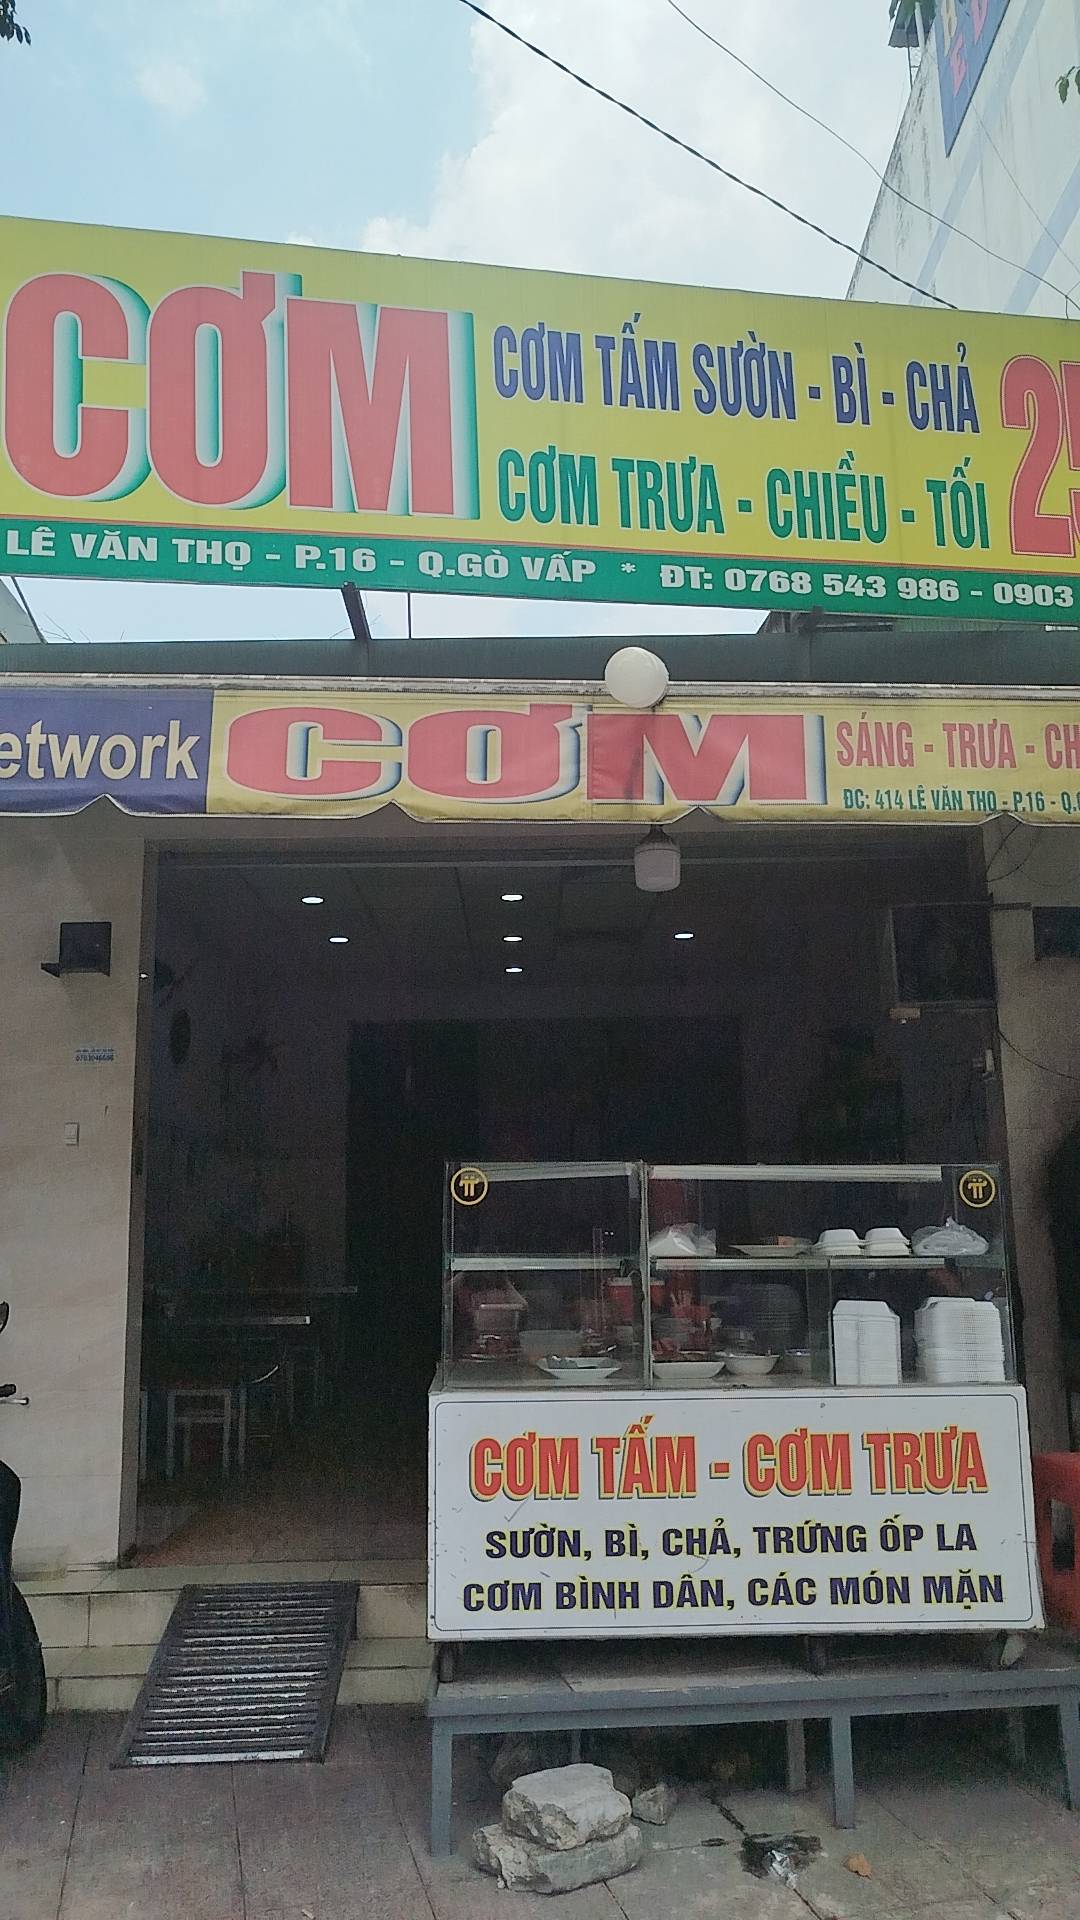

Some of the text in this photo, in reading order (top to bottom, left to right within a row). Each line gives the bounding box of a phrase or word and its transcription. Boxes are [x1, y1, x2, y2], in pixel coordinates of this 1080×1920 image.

[4, 271, 481, 519] CƠM
[492, 321, 584, 404] CƠM
[594, 312, 681, 412] TẤM
[691, 330, 797, 420] SƯỜN
[831, 342, 871, 426] BÌ
[905, 342, 980, 434] CHẢ
[498, 444, 599, 527] CƠM
[611, 455, 725, 534] TRƯA
[766, 450, 888, 545] CHIỀU
[926, 457, 990, 549] TỐI
[6, 526, 56, 557] LÊ
[70, 529, 158, 562] VĂN
[172, 538, 251, 571] THỌ
[295, 545, 376, 572] P.16
[418, 549, 509, 578] Q.GÒ
[520, 551, 596, 583] VẤP
[660, 564, 713, 590] ĐT:
[724, 568, 812, 594] 0768
[823, 574, 887, 597] 543
[896, 577, 959, 601] 986
[993, 582, 1074, 608] 0903
[0, 719, 200, 780] etwork
[226, 703, 827, 804] CƠM
[836, 712, 915, 767] SÁNG
[942, 718, 1017, 769] TRƯA
[843, 788, 871, 810] ĐC:
[875, 789, 903, 810] 414
[908, 785, 926, 810] LÊ
[931, 786, 963, 811] VĂN
[1013, 791, 1045, 812] P.16
[470, 1431, 580, 1501] CƠM
[591, 1415, 697, 1500] TẤM
[742, 1428, 853, 1497] CƠM
[861, 1425, 989, 1495] TRƯA
[485, 1514, 977, 1560] SƯỜN, BÌ, CHẢ, TRỨNG ỐP LA
[463, 1568, 1004, 1611] CƠM BÌNH DÂN, CÁC MÓN MẶN
